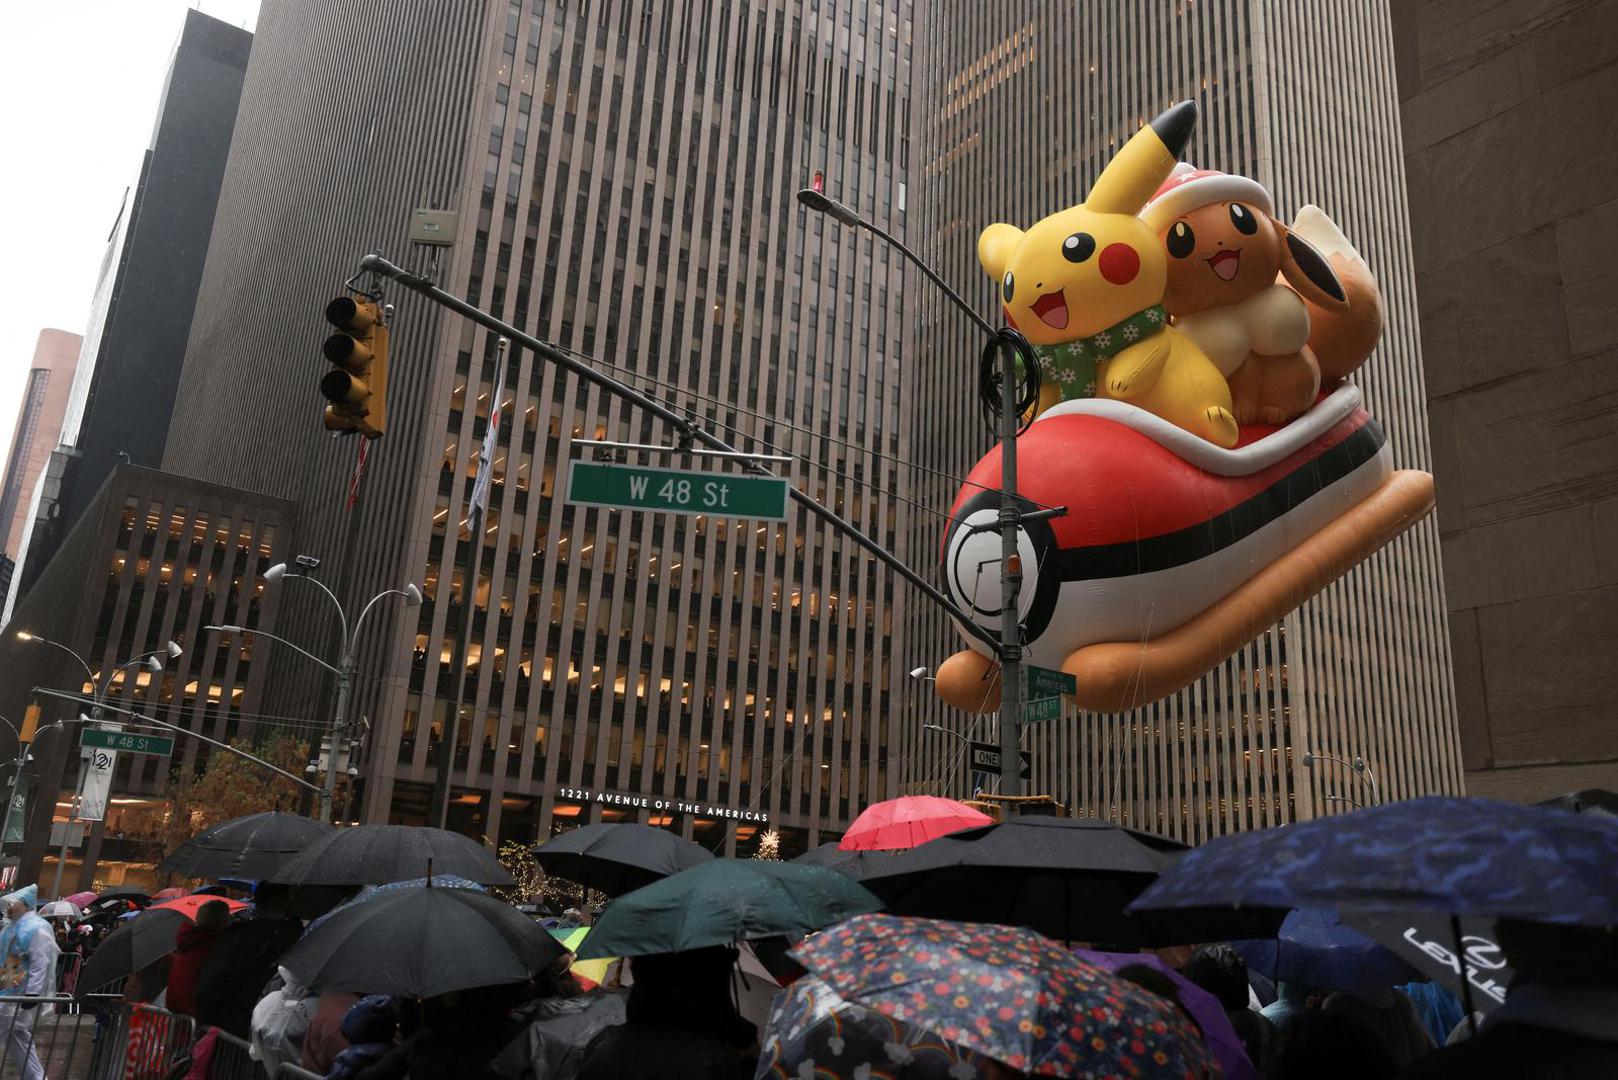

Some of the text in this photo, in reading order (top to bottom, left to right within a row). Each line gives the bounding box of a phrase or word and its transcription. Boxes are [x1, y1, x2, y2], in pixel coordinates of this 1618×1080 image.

[629, 475, 729, 507] W 48 St
[1028, 703, 1036, 720] W
[1036, 702, 1048, 719] 48
[106, 734, 149, 750] W 48 St
[978, 751, 998, 766] ONE
[560, 788, 768, 822] 1221 AVENUE OF THE AMERICAS
